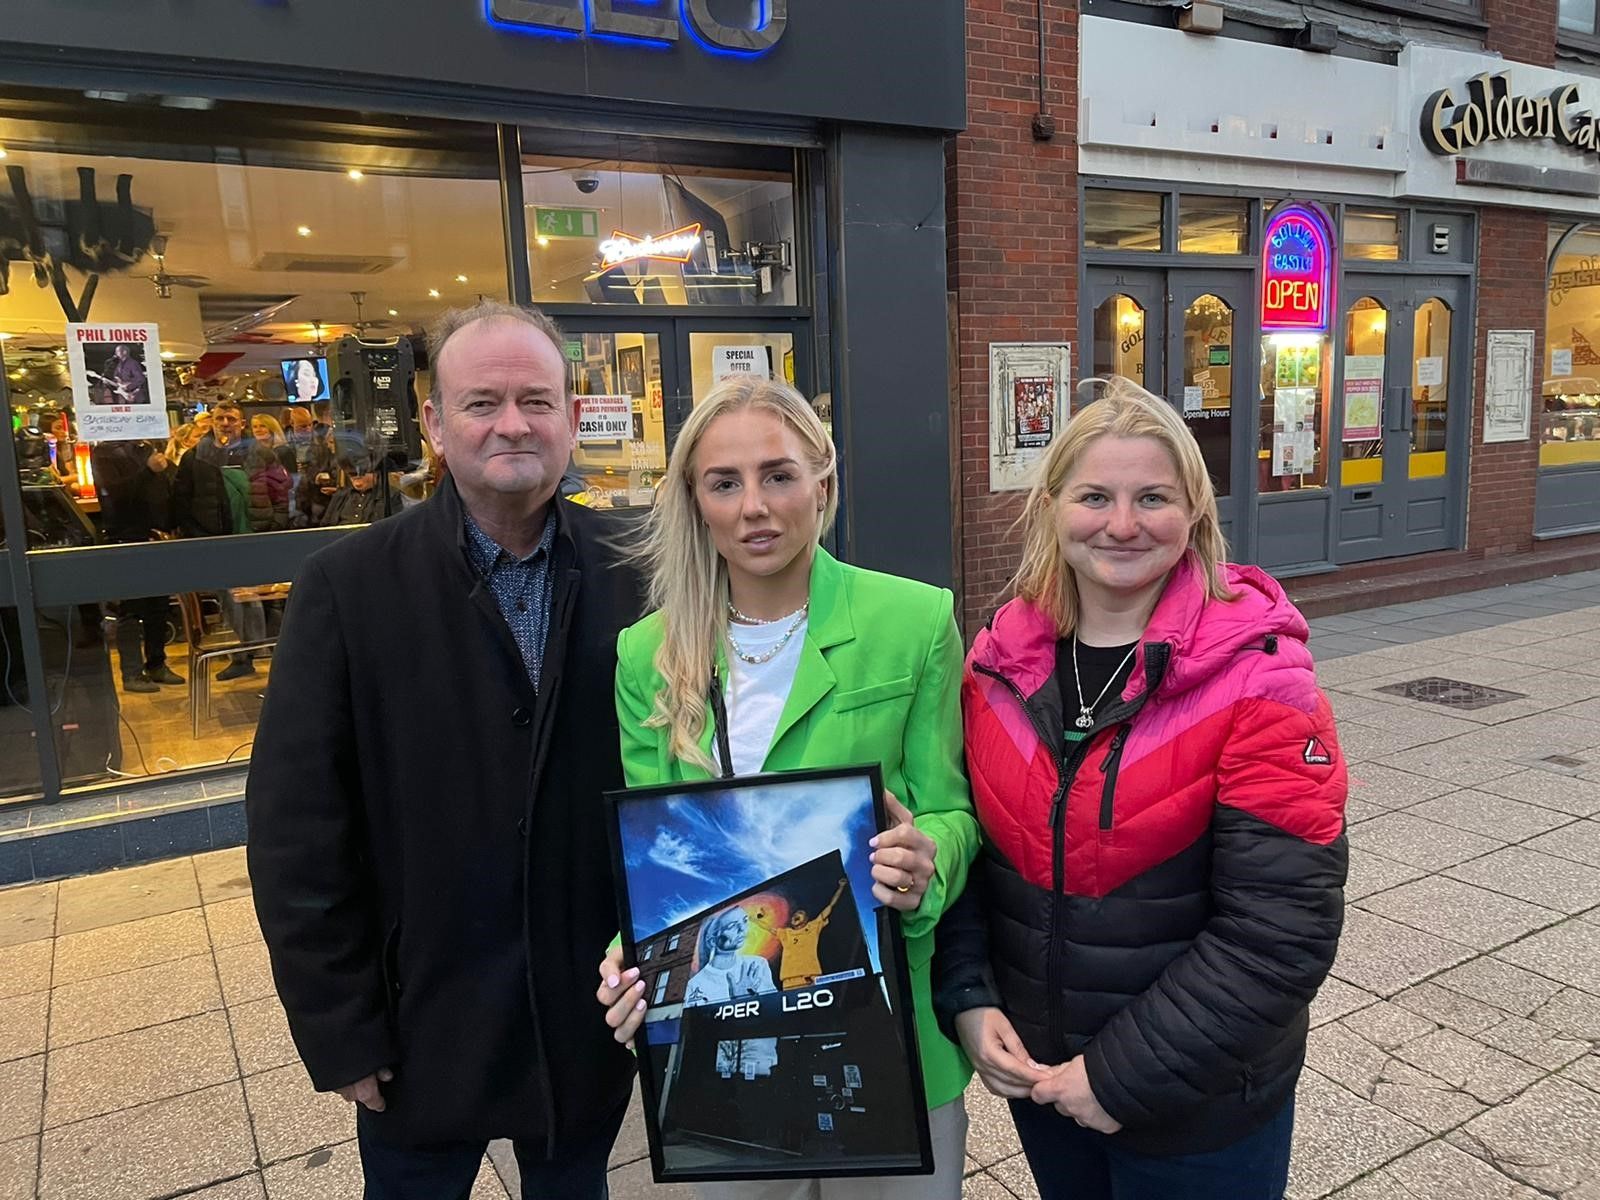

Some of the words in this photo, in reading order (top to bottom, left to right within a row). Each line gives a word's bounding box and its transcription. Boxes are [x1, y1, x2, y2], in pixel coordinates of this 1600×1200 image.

[1421, 70, 1556, 155] Golden
[1266, 279, 1318, 310] OPEN
[77, 329, 106, 341] PHIL
[109, 329, 149, 342] JONES
[726, 350, 754, 360] SPECIAL
[730, 362, 751, 371] OFFER
[600, 397, 624, 405] CHARGES
[83, 415, 131, 426] SATURDAY
[1183, 411, 1210, 420] Opening
[1211, 410, 1231, 418] Hours
[580, 421, 604, 433] CASH
[605, 421, 627, 432] ONLY
